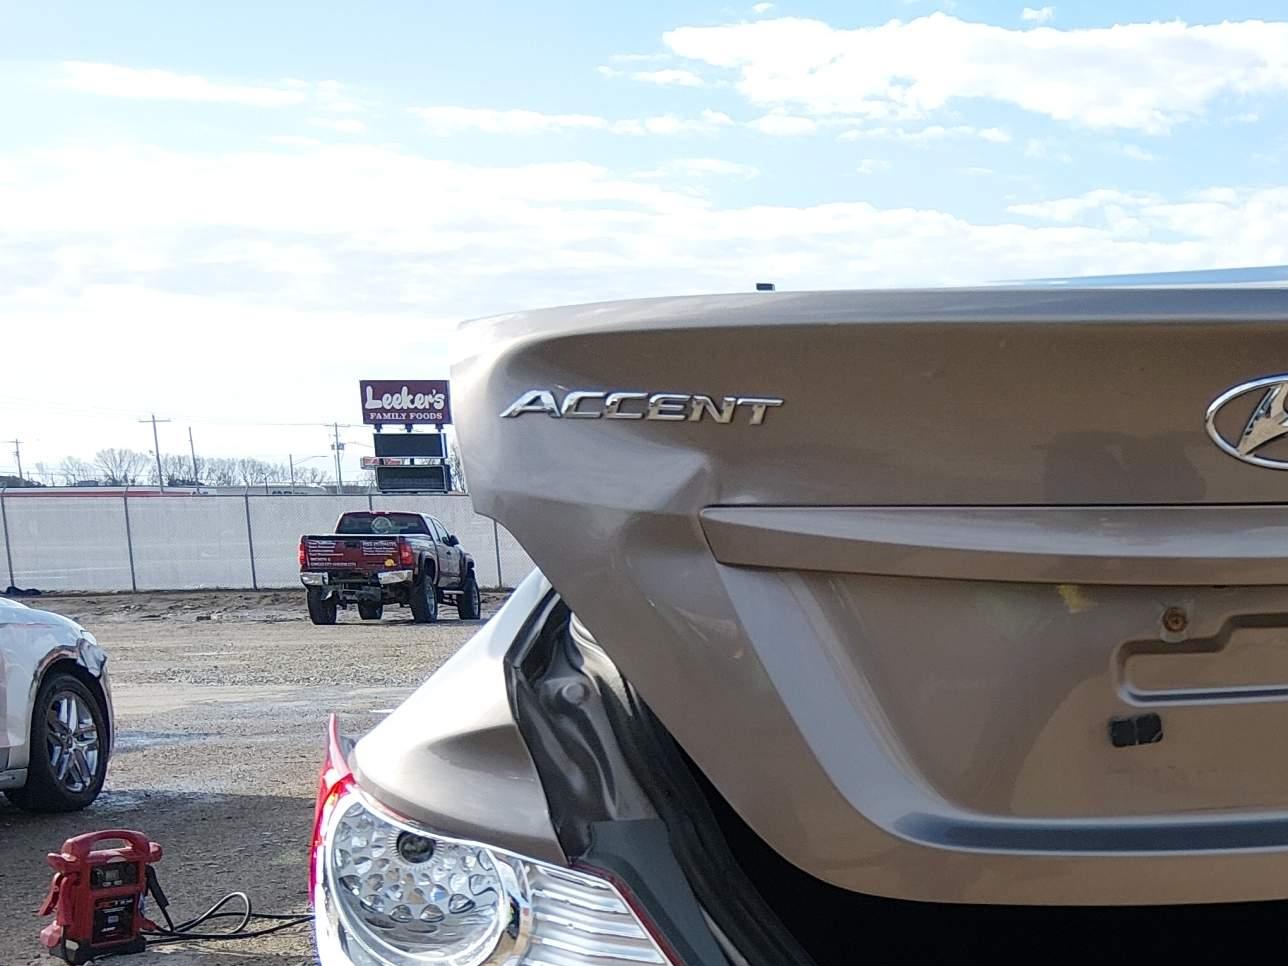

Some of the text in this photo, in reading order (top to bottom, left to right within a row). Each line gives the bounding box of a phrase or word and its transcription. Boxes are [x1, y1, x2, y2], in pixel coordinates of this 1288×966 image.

[364, 385, 446, 410] Leeker's
[499, 389, 784, 425] ACCENT
[369, 412, 443, 420] FAMILY FOODS
